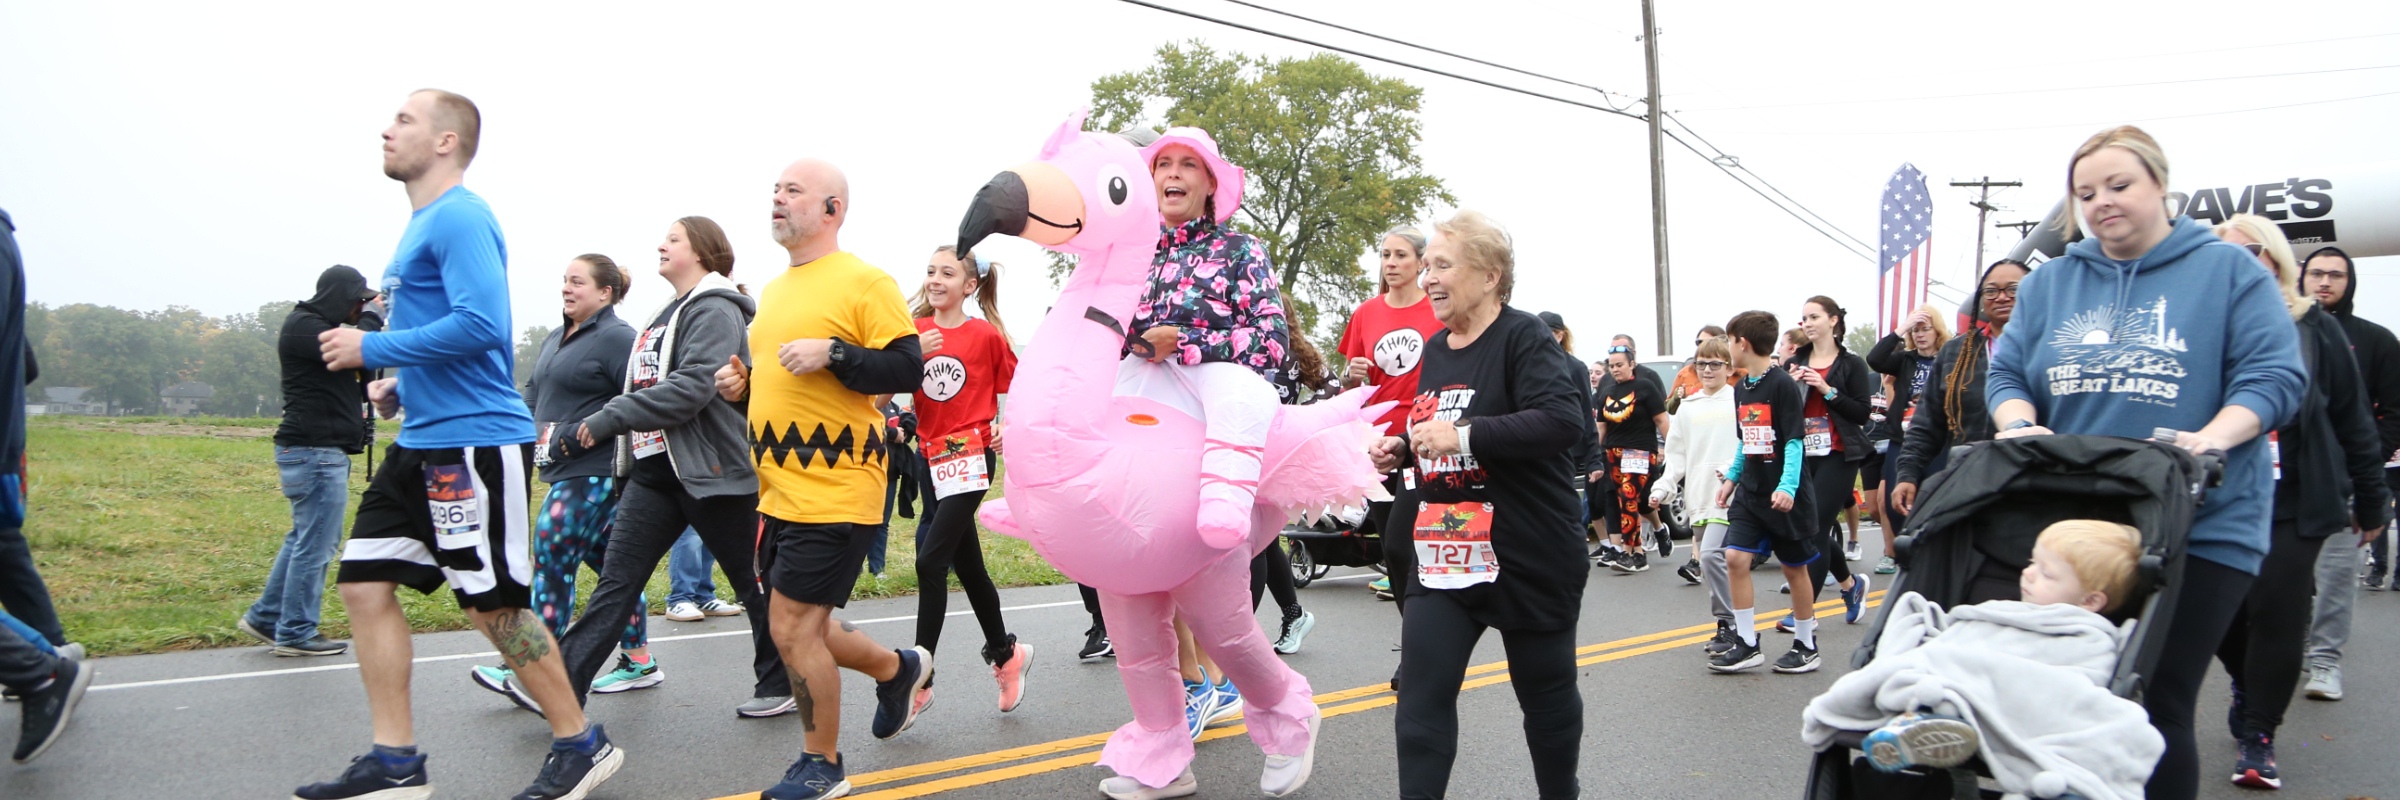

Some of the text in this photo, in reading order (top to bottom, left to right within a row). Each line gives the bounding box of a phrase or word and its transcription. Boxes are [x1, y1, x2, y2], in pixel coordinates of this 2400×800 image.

[2166, 177, 2333, 225] DAVE'S
[1377, 335, 1418, 354] THING
[1395, 353, 1406, 369] 1
[924, 362, 962, 381] THING
[2046, 364, 2082, 381] THE
[937, 381, 947, 396] 2
[2049, 378, 2180, 399] GREAT LAKES
[1437, 388, 1476, 410] RUN
[1744, 428, 1761, 440] 851
[936, 459, 969, 482] 602
[1427, 543, 1473, 565] 727
